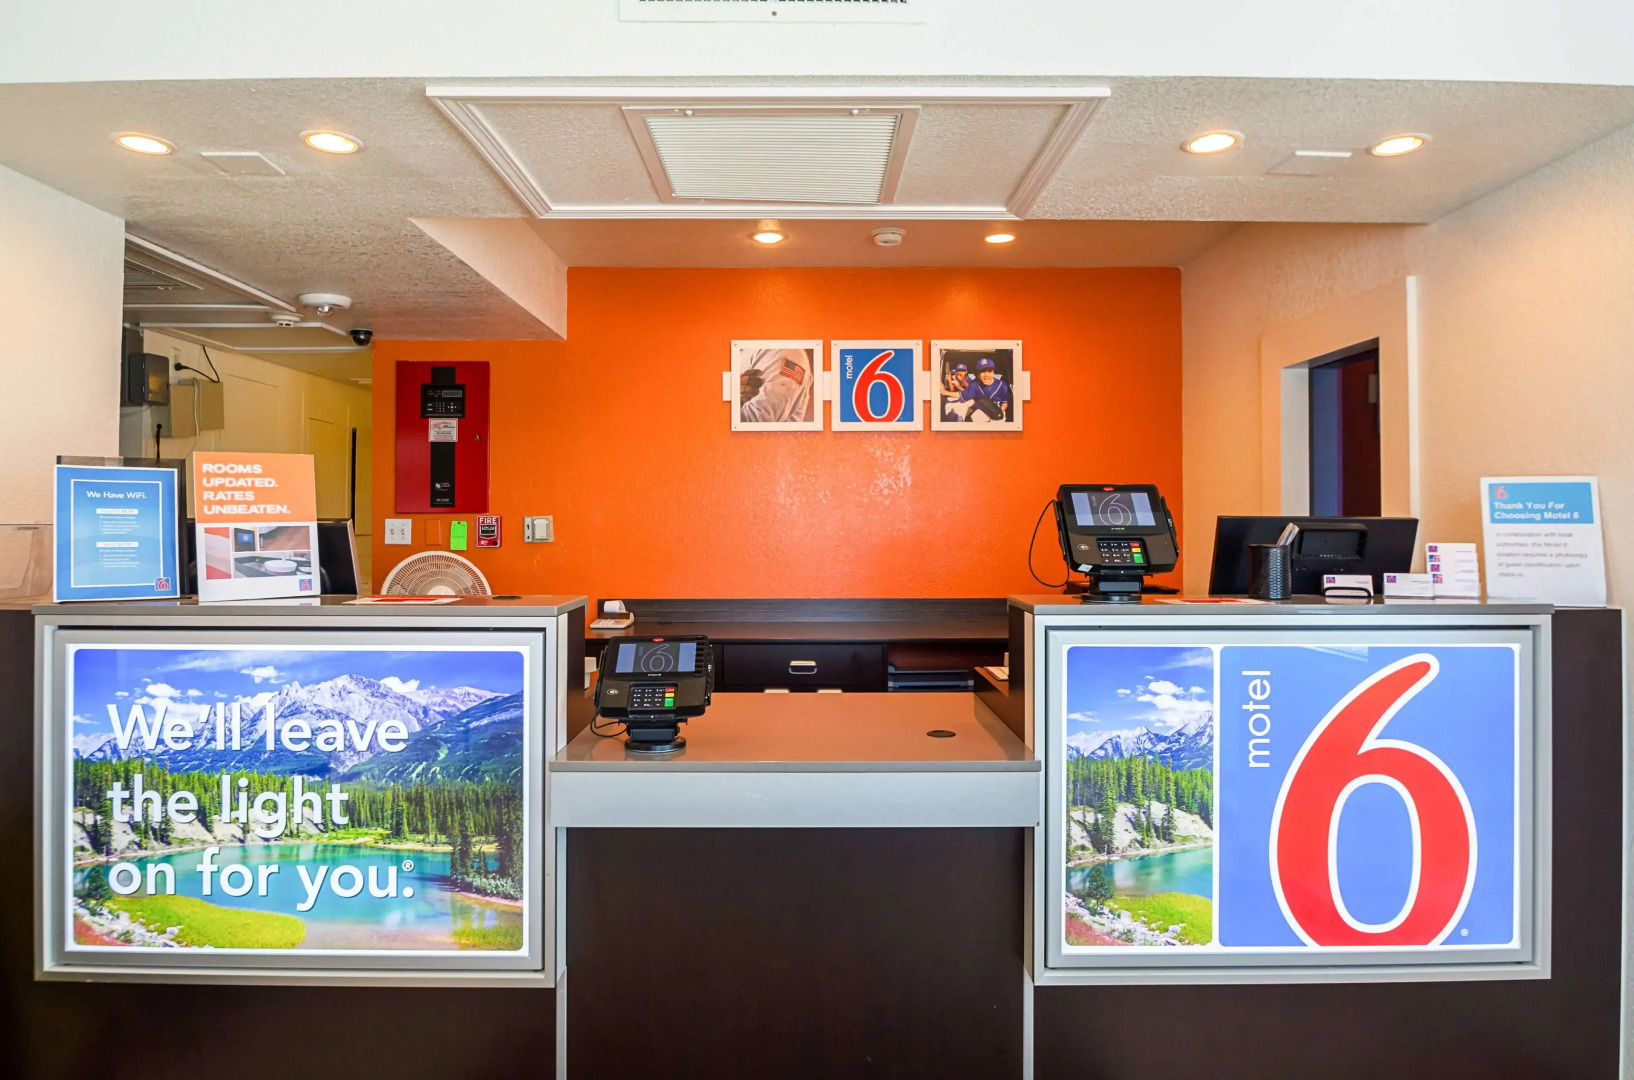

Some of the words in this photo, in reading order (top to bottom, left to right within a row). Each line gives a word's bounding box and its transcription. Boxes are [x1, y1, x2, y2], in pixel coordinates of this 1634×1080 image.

[844, 355, 853, 379] motel
[852, 350, 905, 422] 6
[202, 463, 262, 474] ROOMS
[202, 477, 279, 488] UPDATED.
[86, 490, 101, 498] We
[103, 491, 125, 499] Have
[203, 491, 255, 501] RATES
[1495, 486, 1507, 499] 6
[203, 504, 291, 515] UNBEATEN.
[1099, 493, 1132, 526] 6
[1493, 501, 1523, 509] Thank
[1526, 501, 1546, 509] You
[1548, 501, 1565, 509] For
[1494, 511, 1541, 520] Choosing
[1543, 511, 1571, 519] Motel
[1573, 511, 1580, 519] 6
[157, 577, 169, 591] 6
[301, 579, 312, 591] 6
[641, 643, 674, 672] 6
[107, 703, 241, 752] We’ll
[265, 703, 409, 752] leave
[1242, 669, 1271, 769] motel
[1269, 652, 1478, 946] 6
[106, 774, 198, 824] the
[221, 774, 349, 839] light
[107, 861, 176, 896] on
[196, 846, 280, 897] for
